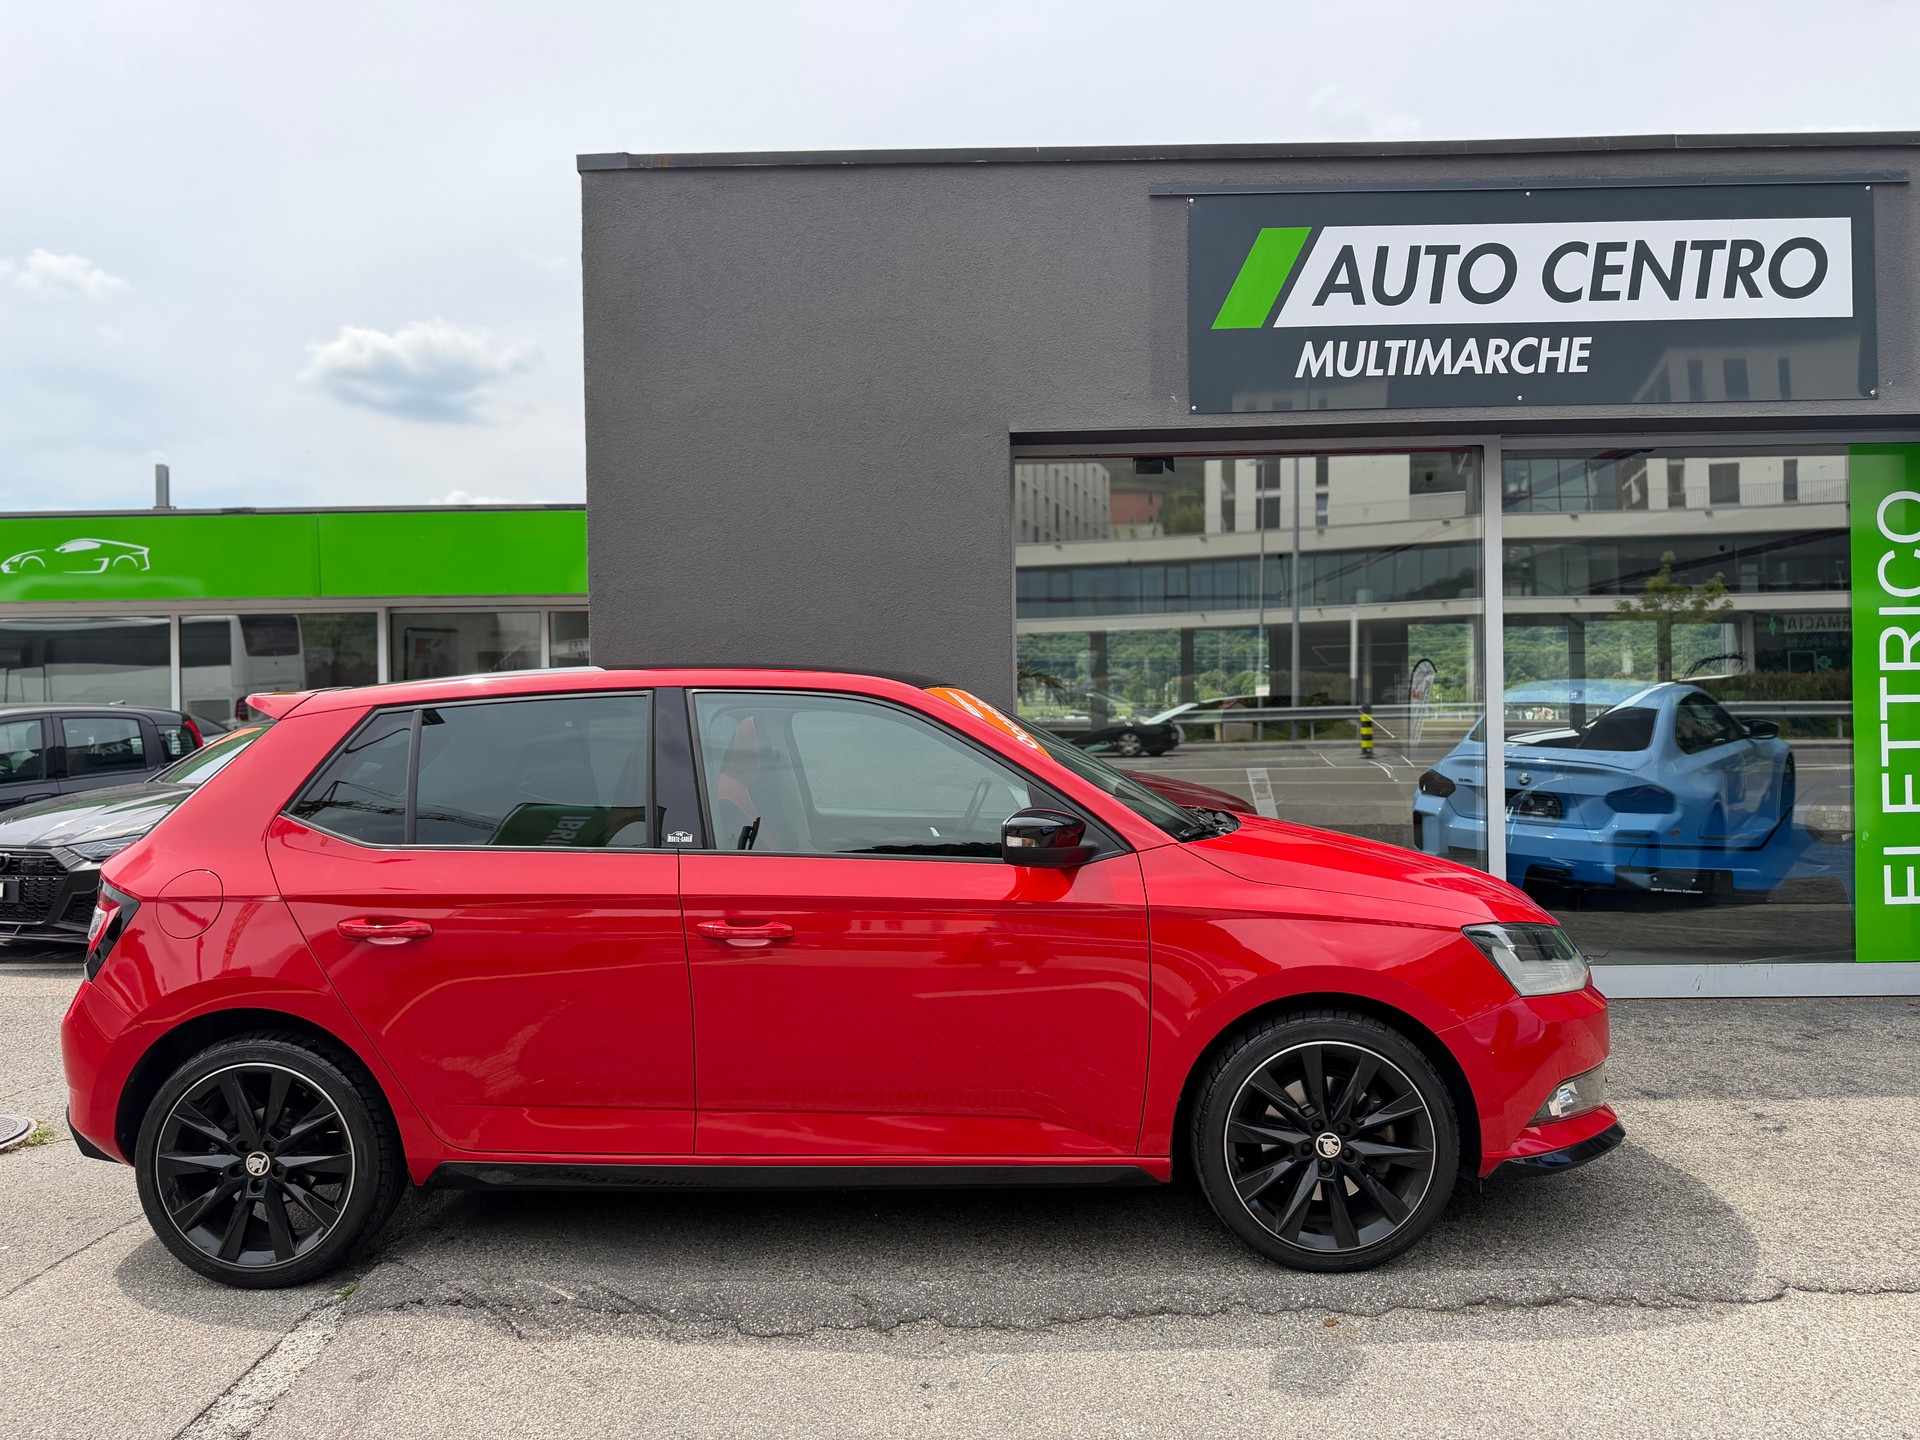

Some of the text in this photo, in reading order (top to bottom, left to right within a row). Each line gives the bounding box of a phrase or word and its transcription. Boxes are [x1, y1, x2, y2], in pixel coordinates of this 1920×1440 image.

[1311, 236, 1829, 307] AUTO CENTRO
[1294, 336, 1593, 379] MULTIMARCHE
[541, 815, 592, 846] IBRI
